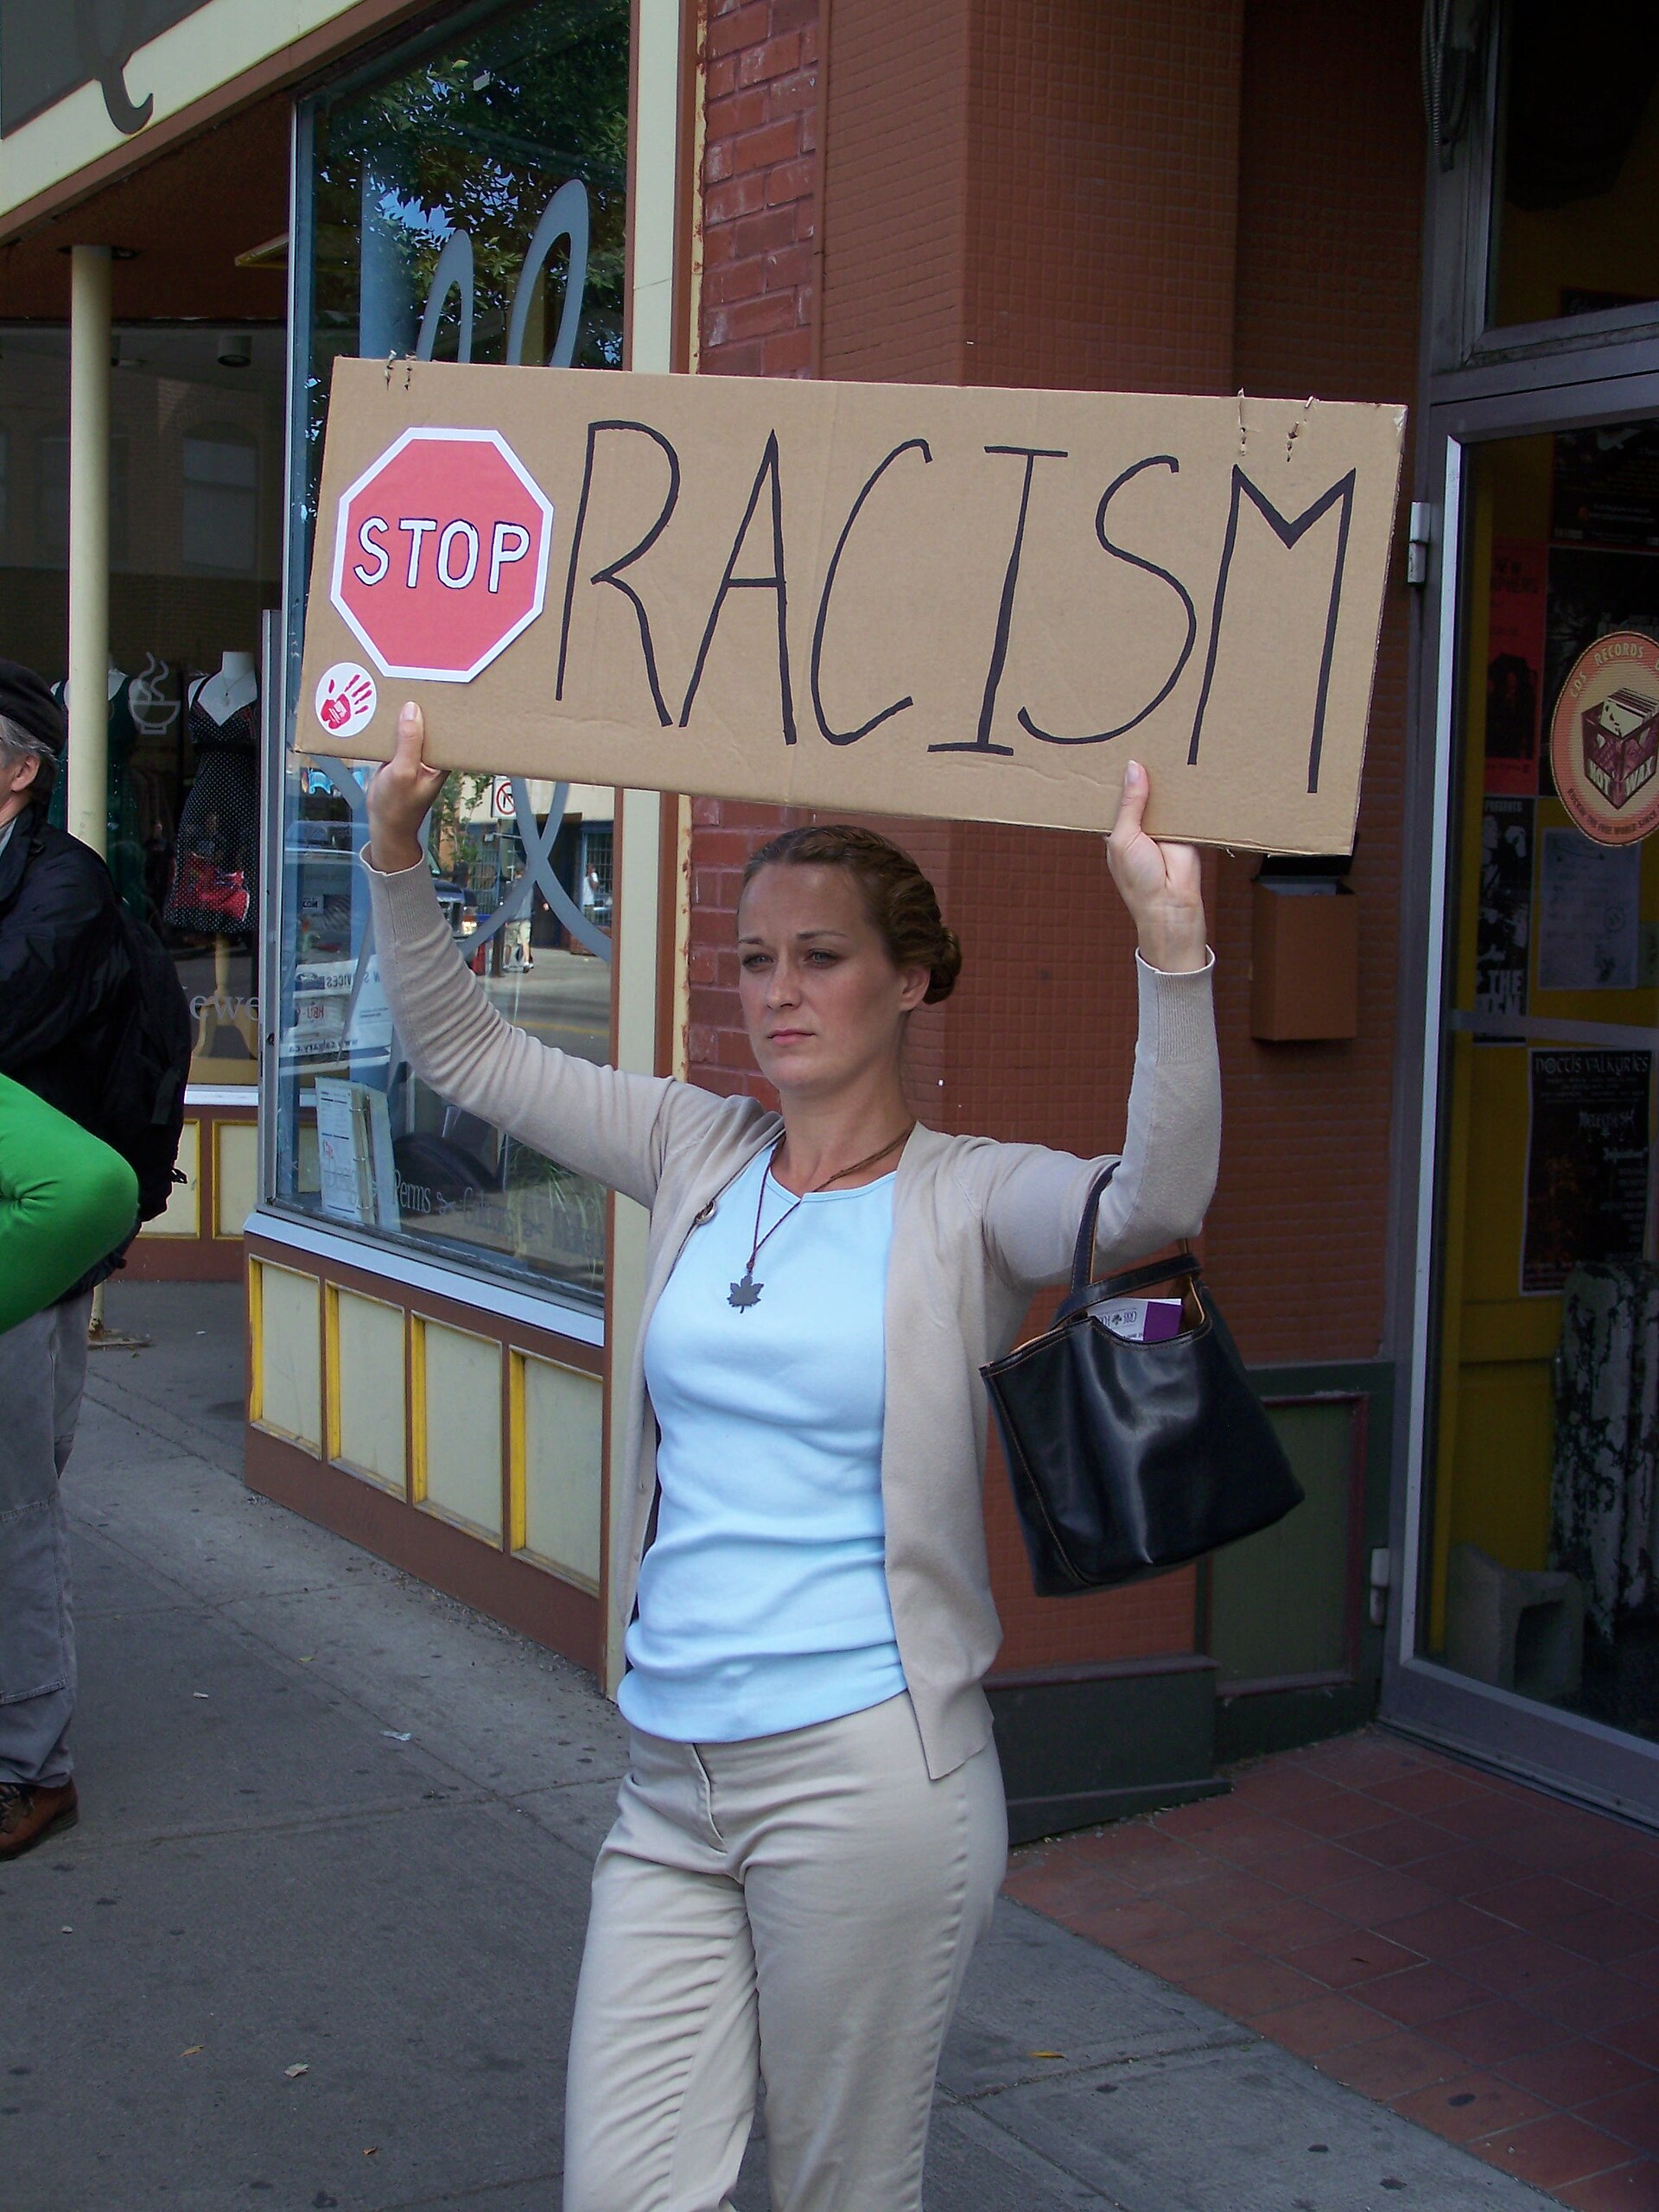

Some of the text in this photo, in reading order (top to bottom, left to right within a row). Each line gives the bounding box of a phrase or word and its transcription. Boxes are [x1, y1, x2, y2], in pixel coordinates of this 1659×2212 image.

[352, 420, 1356, 793] STOP RACISM
[1593, 642, 1644, 666] RECORDS
[393, 1169, 431, 1214] Perms
